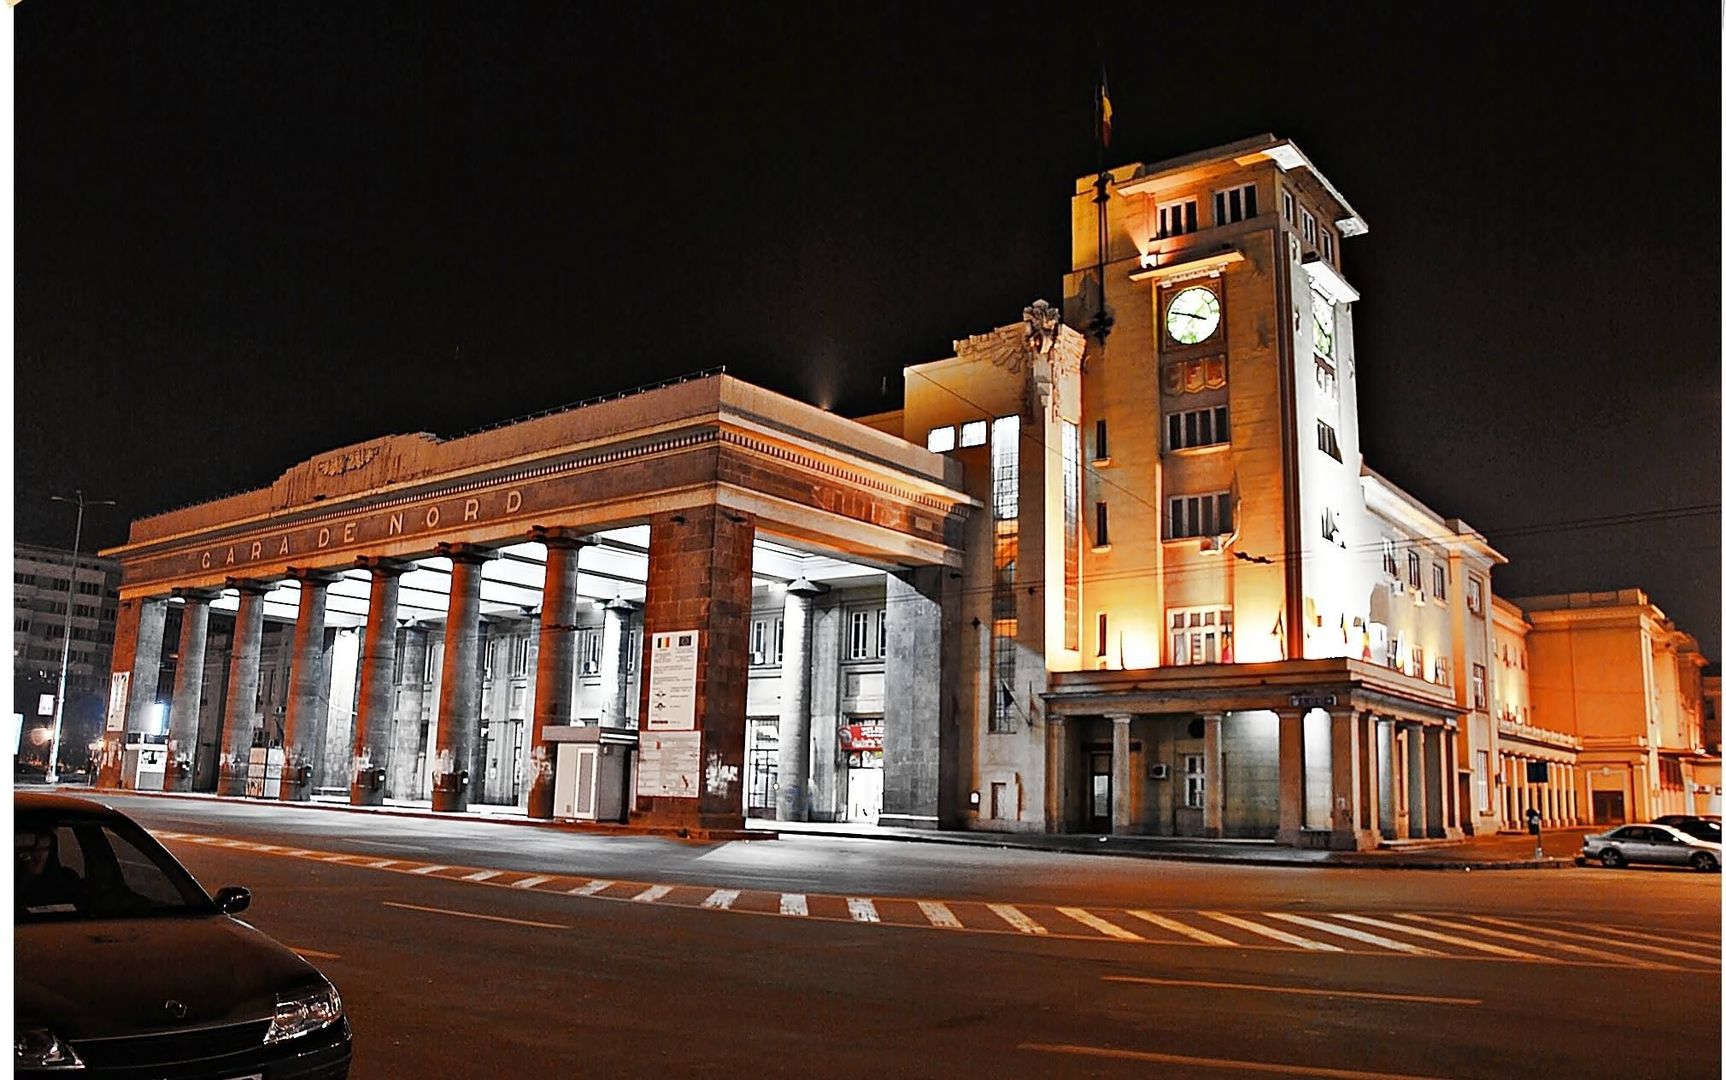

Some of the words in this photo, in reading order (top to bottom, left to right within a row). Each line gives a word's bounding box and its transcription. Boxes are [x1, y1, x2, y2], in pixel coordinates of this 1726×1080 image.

[202, 536, 289, 568] GARA
[318, 523, 357, 548] DE
[389, 490, 522, 536] NORD
